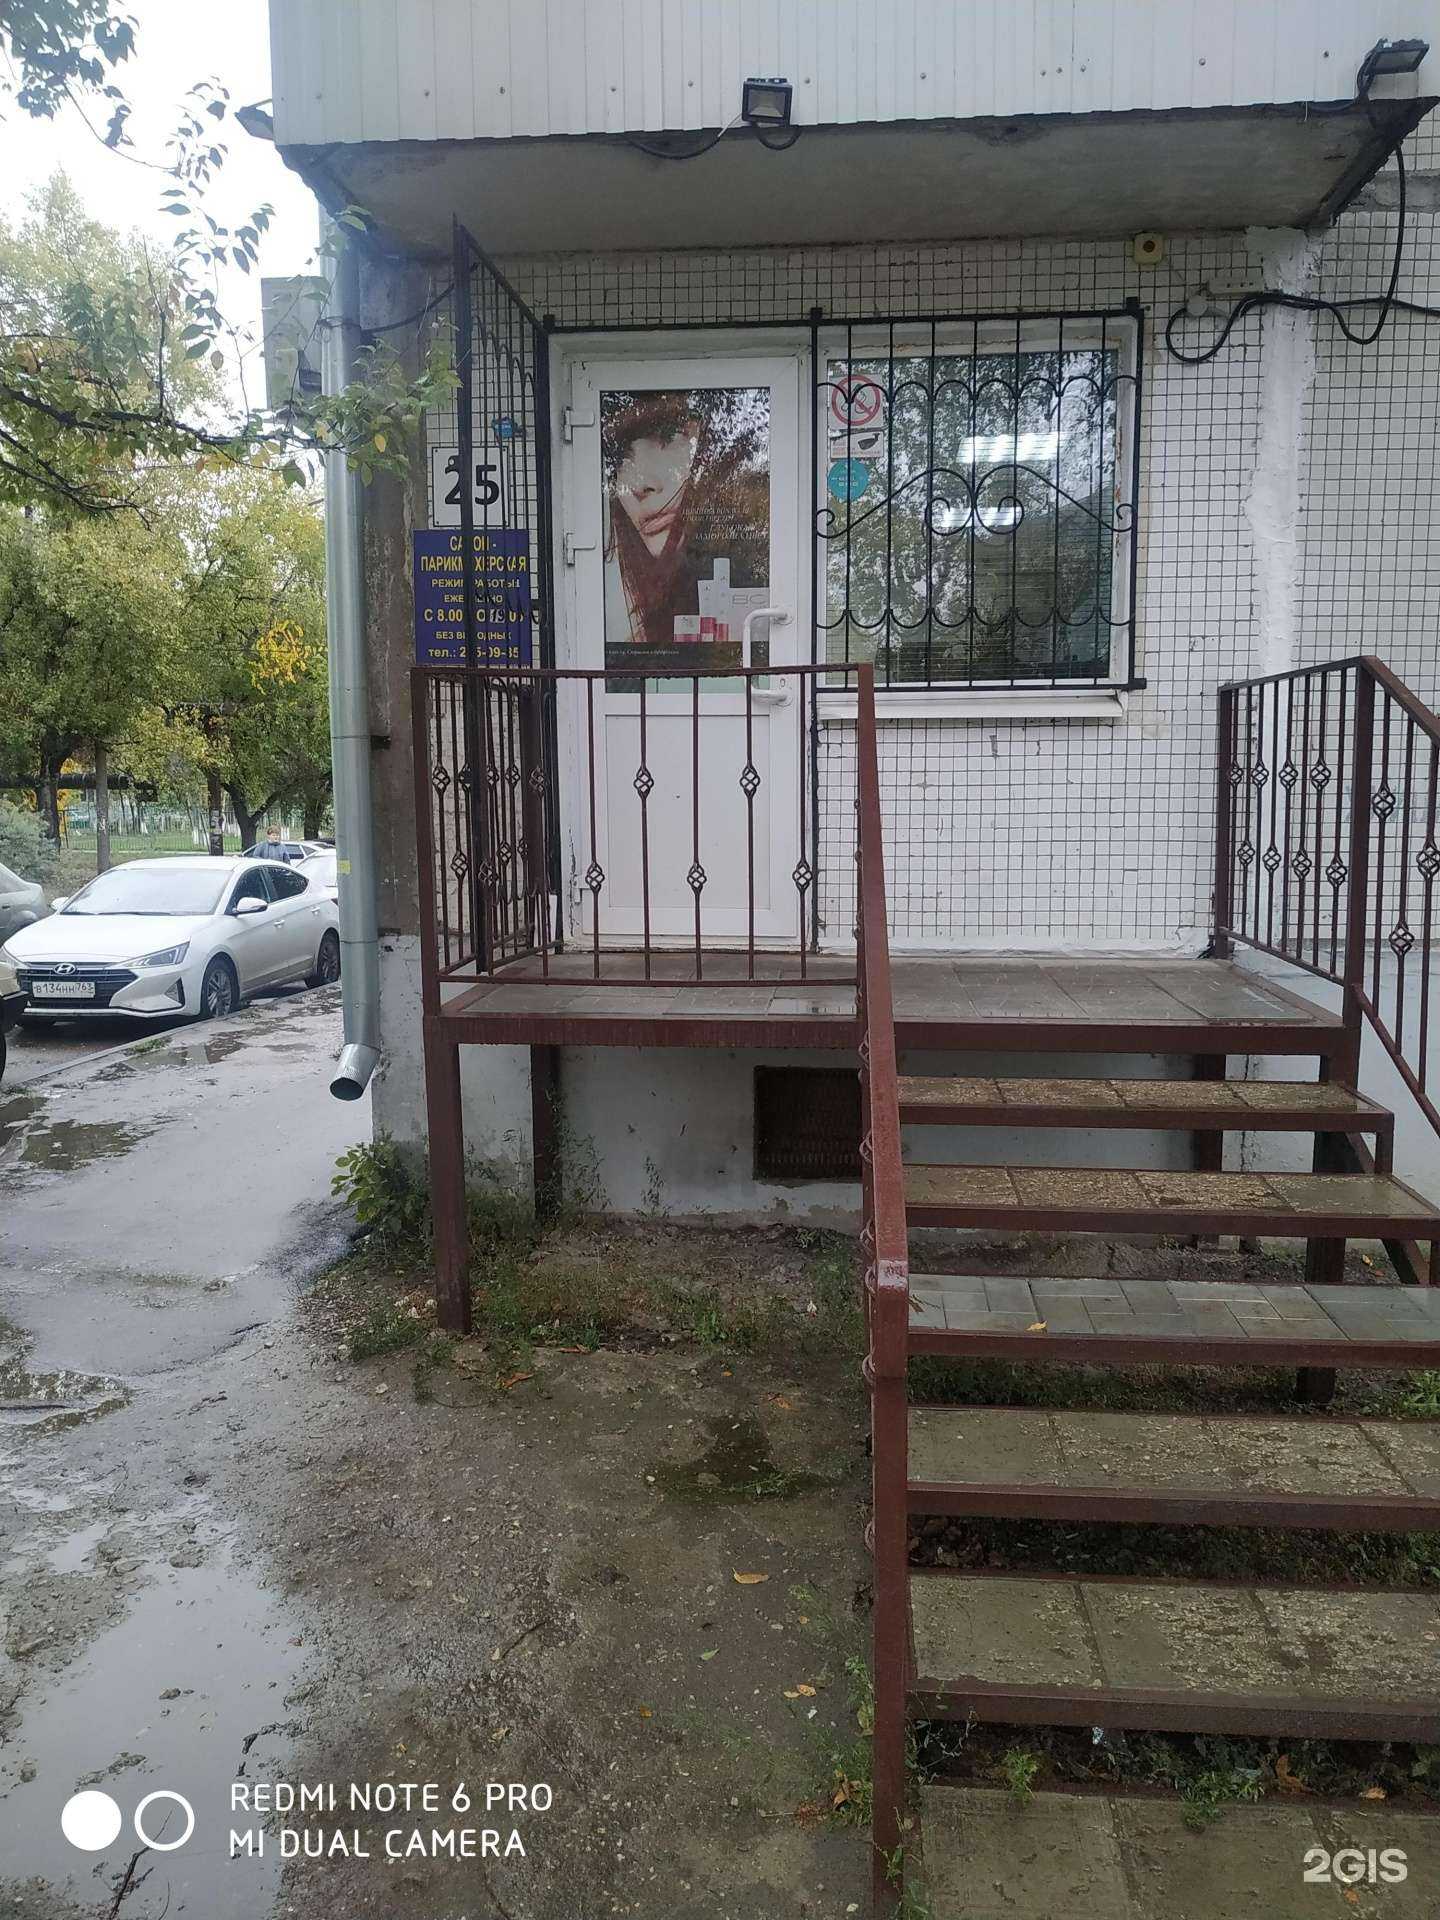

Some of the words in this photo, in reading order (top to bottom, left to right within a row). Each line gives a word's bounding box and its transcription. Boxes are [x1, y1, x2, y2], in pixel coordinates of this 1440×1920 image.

[445, 464, 500, 505] 25
[450, 536, 490, 551] САОН
[421, 555, 526, 572] ПАРИКХЕРСКАЯ
[432, 578, 465, 588] РЕЖИ
[444, 594, 503, 603] ЕЖЕНО
[437, 608, 464, 622] 8.00
[489, 608, 524, 623] 190
[436, 631, 454, 640] БЕЗ
[456, 631, 512, 641] ВОДНЫ
